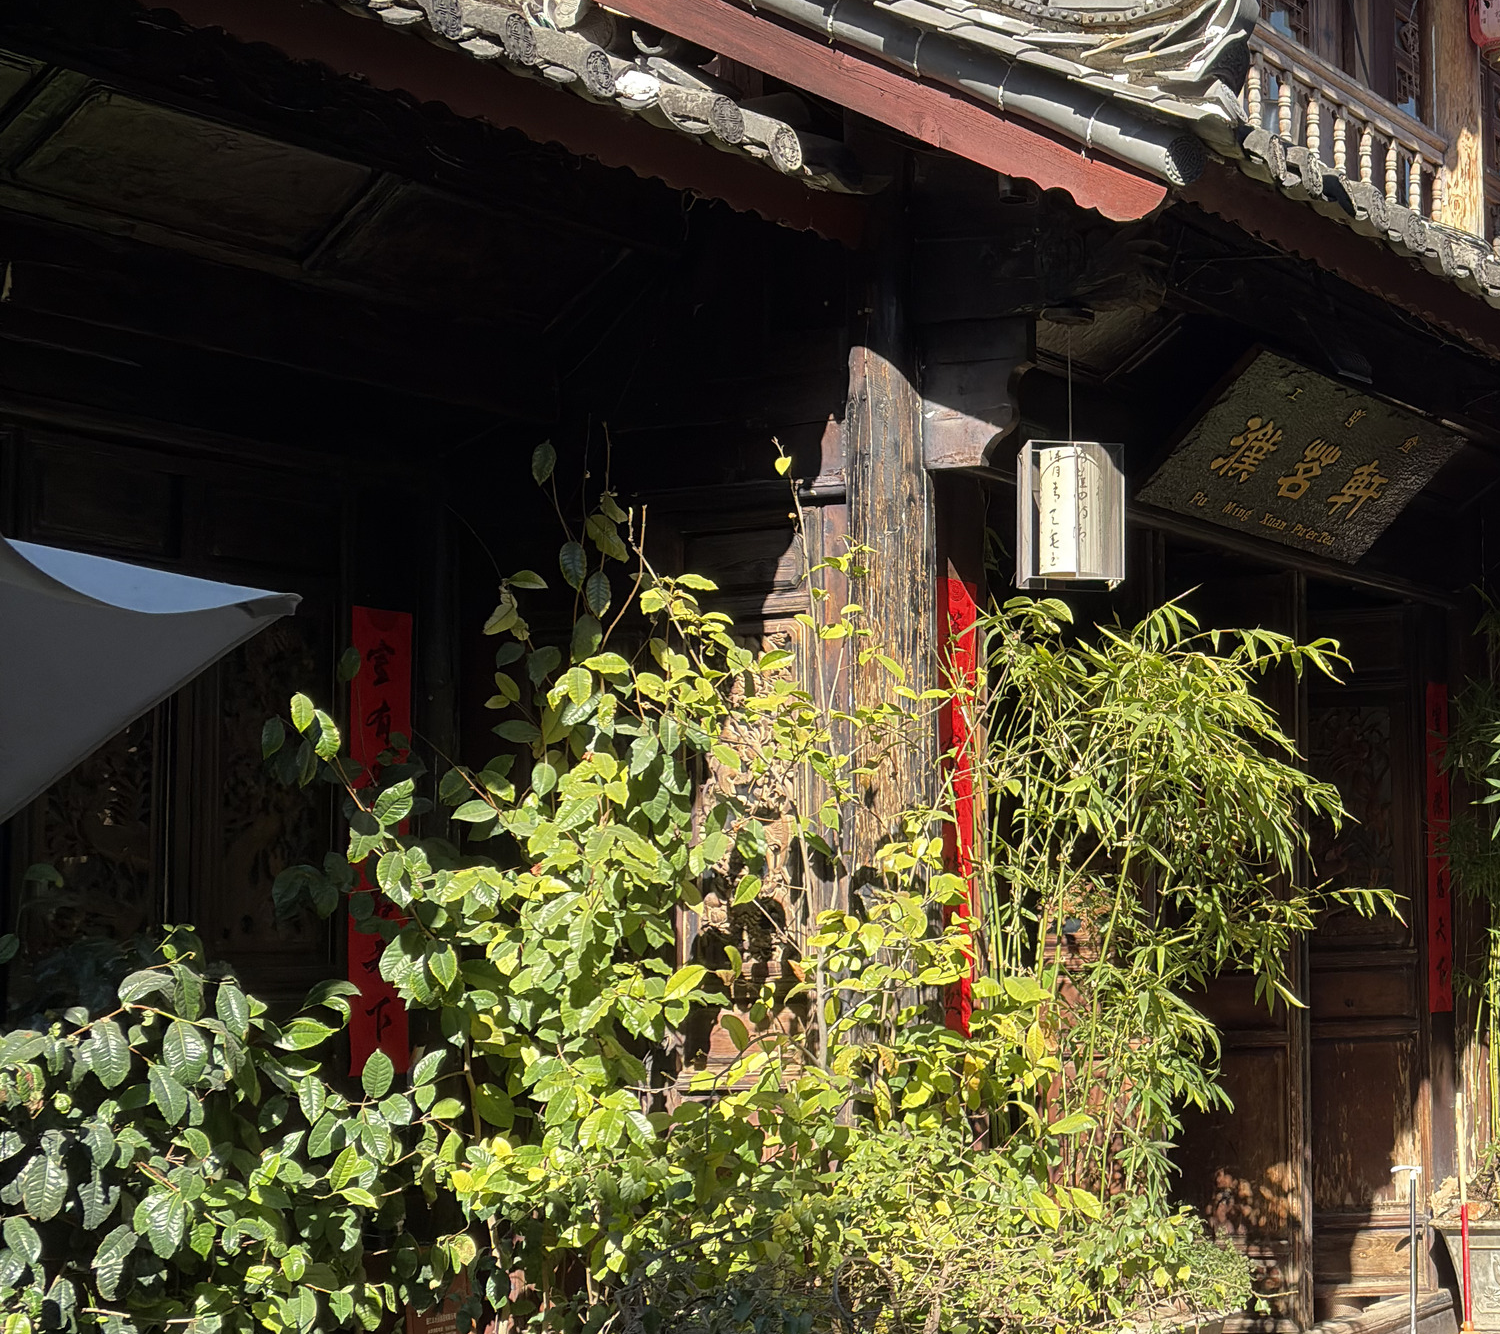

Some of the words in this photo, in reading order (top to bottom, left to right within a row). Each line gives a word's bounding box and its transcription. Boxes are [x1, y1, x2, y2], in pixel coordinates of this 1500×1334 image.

[1189, 491, 1209, 507] Pu
[1222, 501, 1254, 522] Ming
[1259, 512, 1288, 531] Xuan
